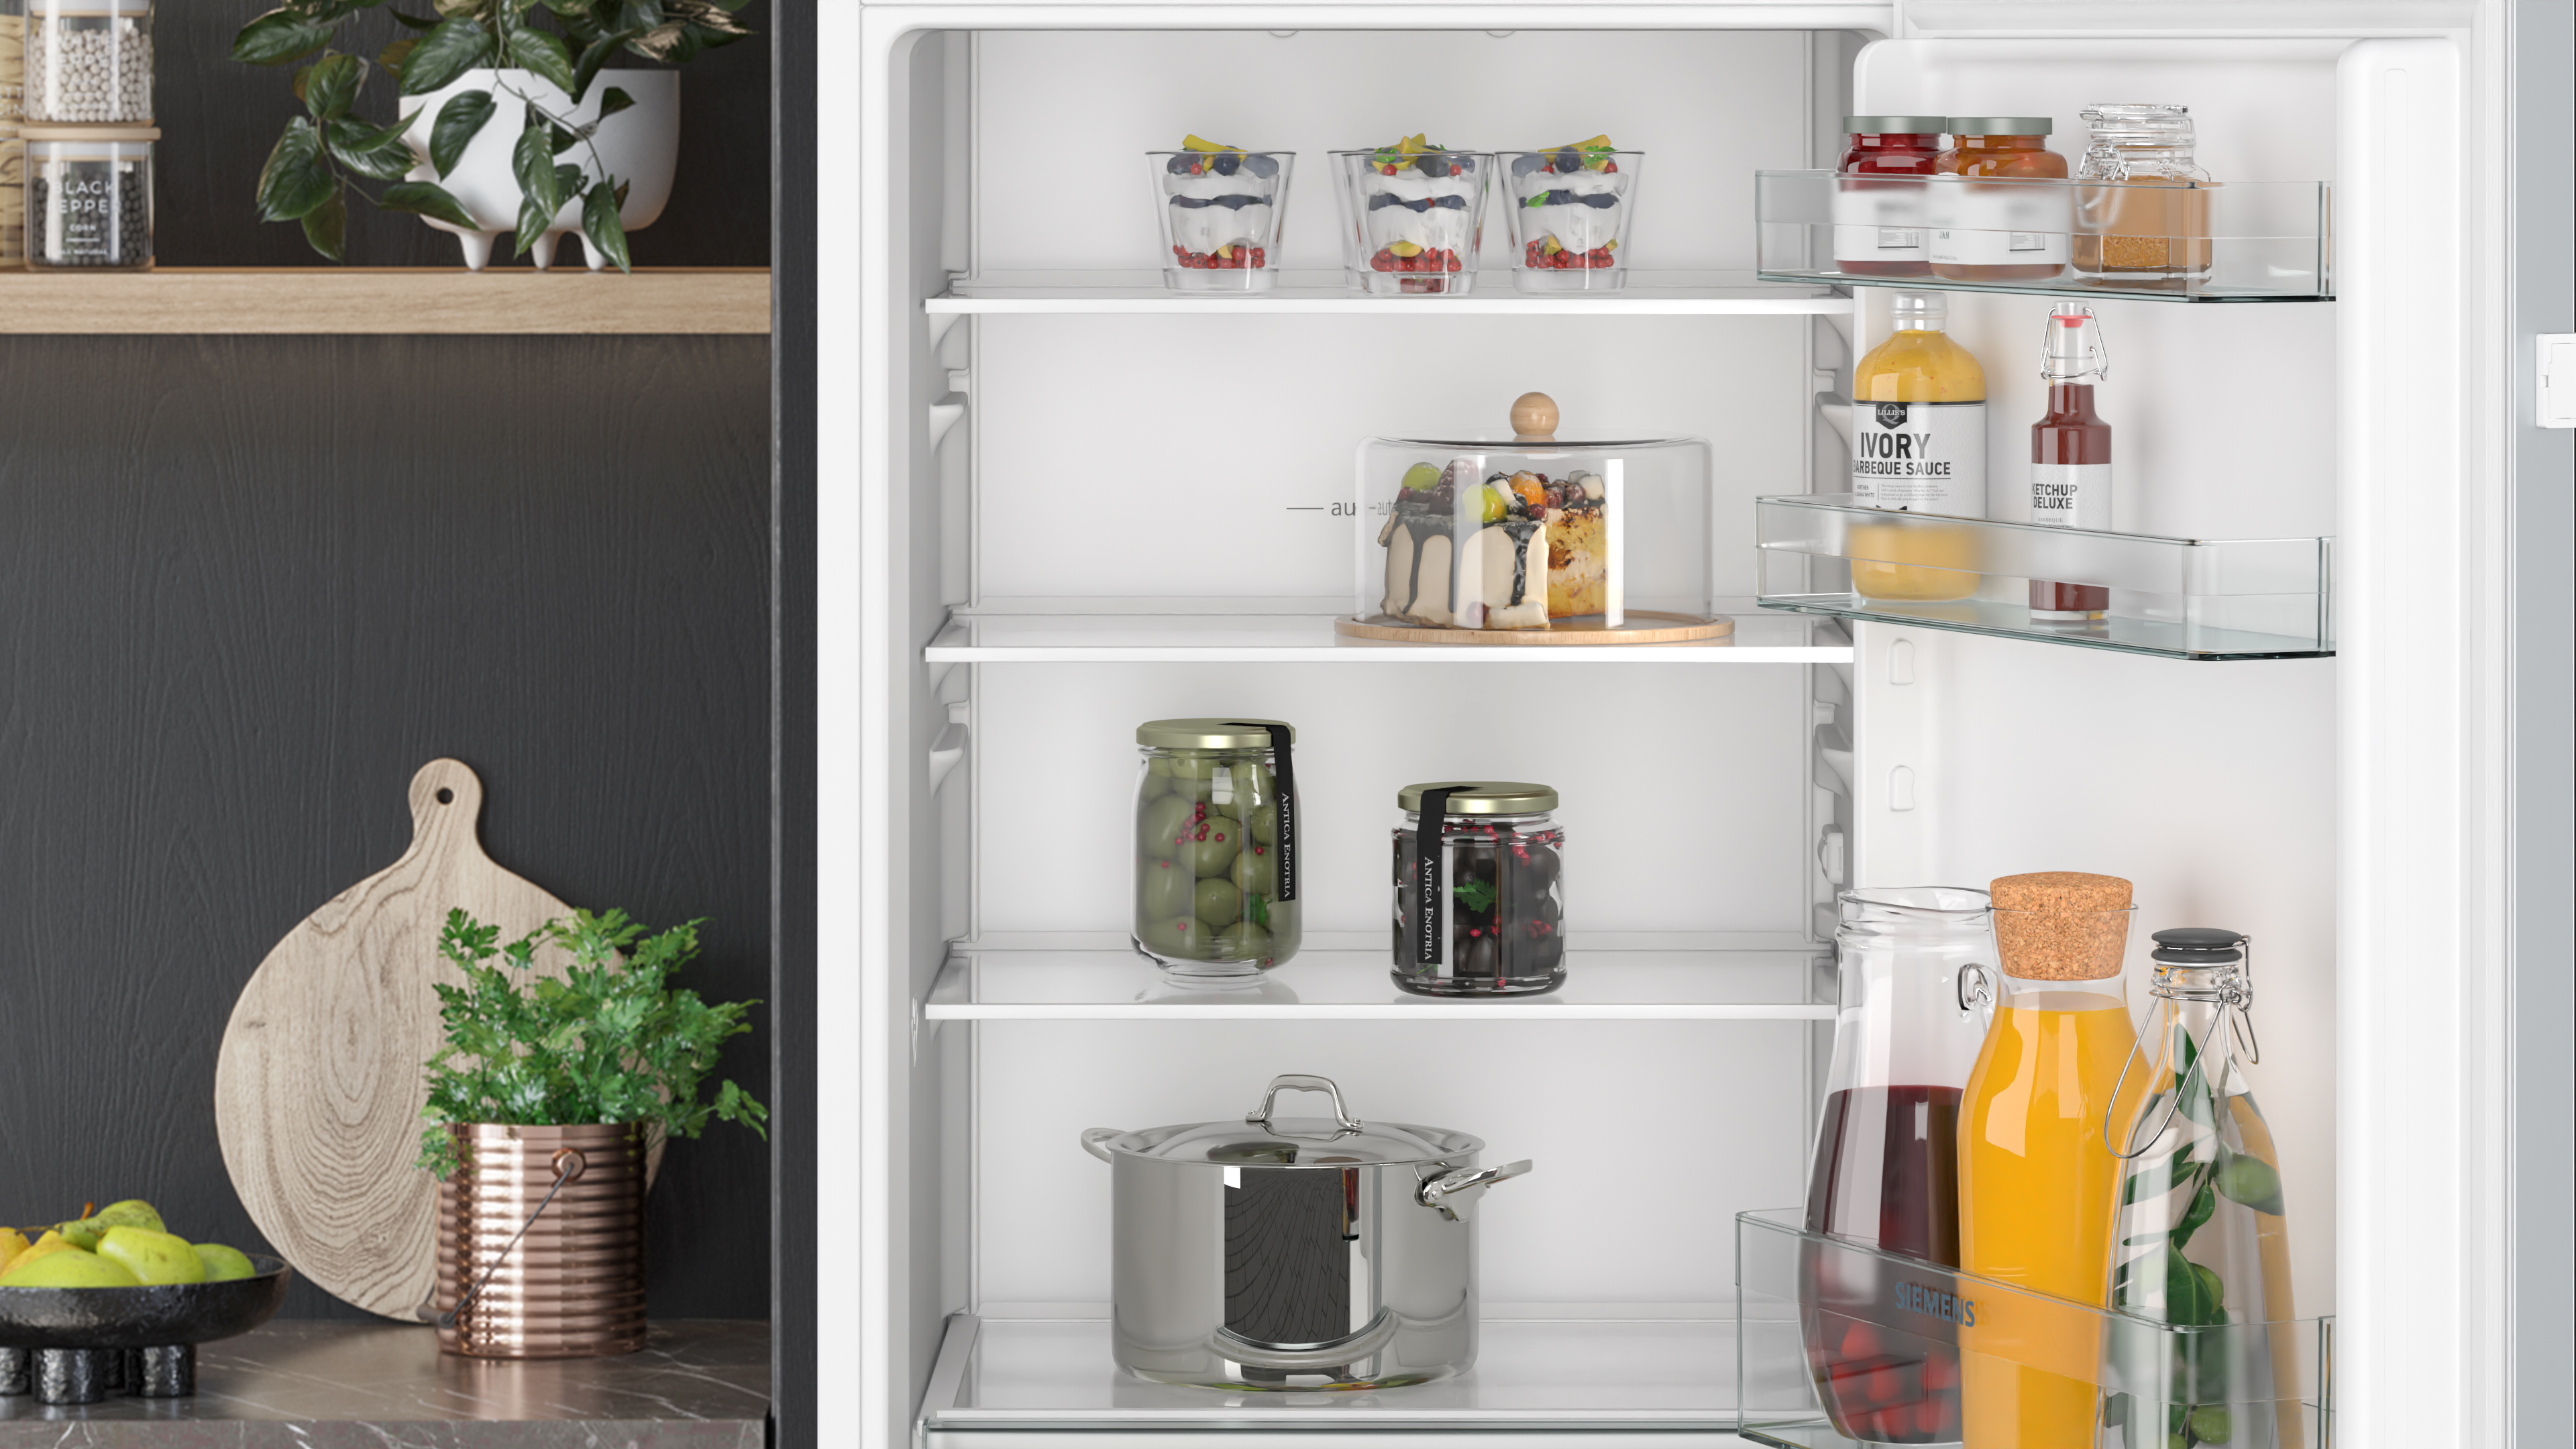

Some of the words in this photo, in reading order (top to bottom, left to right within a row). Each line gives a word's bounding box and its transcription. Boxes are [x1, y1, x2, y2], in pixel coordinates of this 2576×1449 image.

[1861, 432, 1931, 460] IVORY
[1853, 460, 1901, 475] BARBEQUE
[1906, 462, 1951, 476] SAUCE
[2032, 483, 2078, 496] KETCHUP
[2033, 496, 2073, 509] DELUXE
[1282, 792, 1290, 840] ANTICA
[1424, 856, 1434, 904] ANTICA
[1424, 907, 1434, 961] ENOTRIA
[1895, 1282, 1975, 1328] SIEMENS
